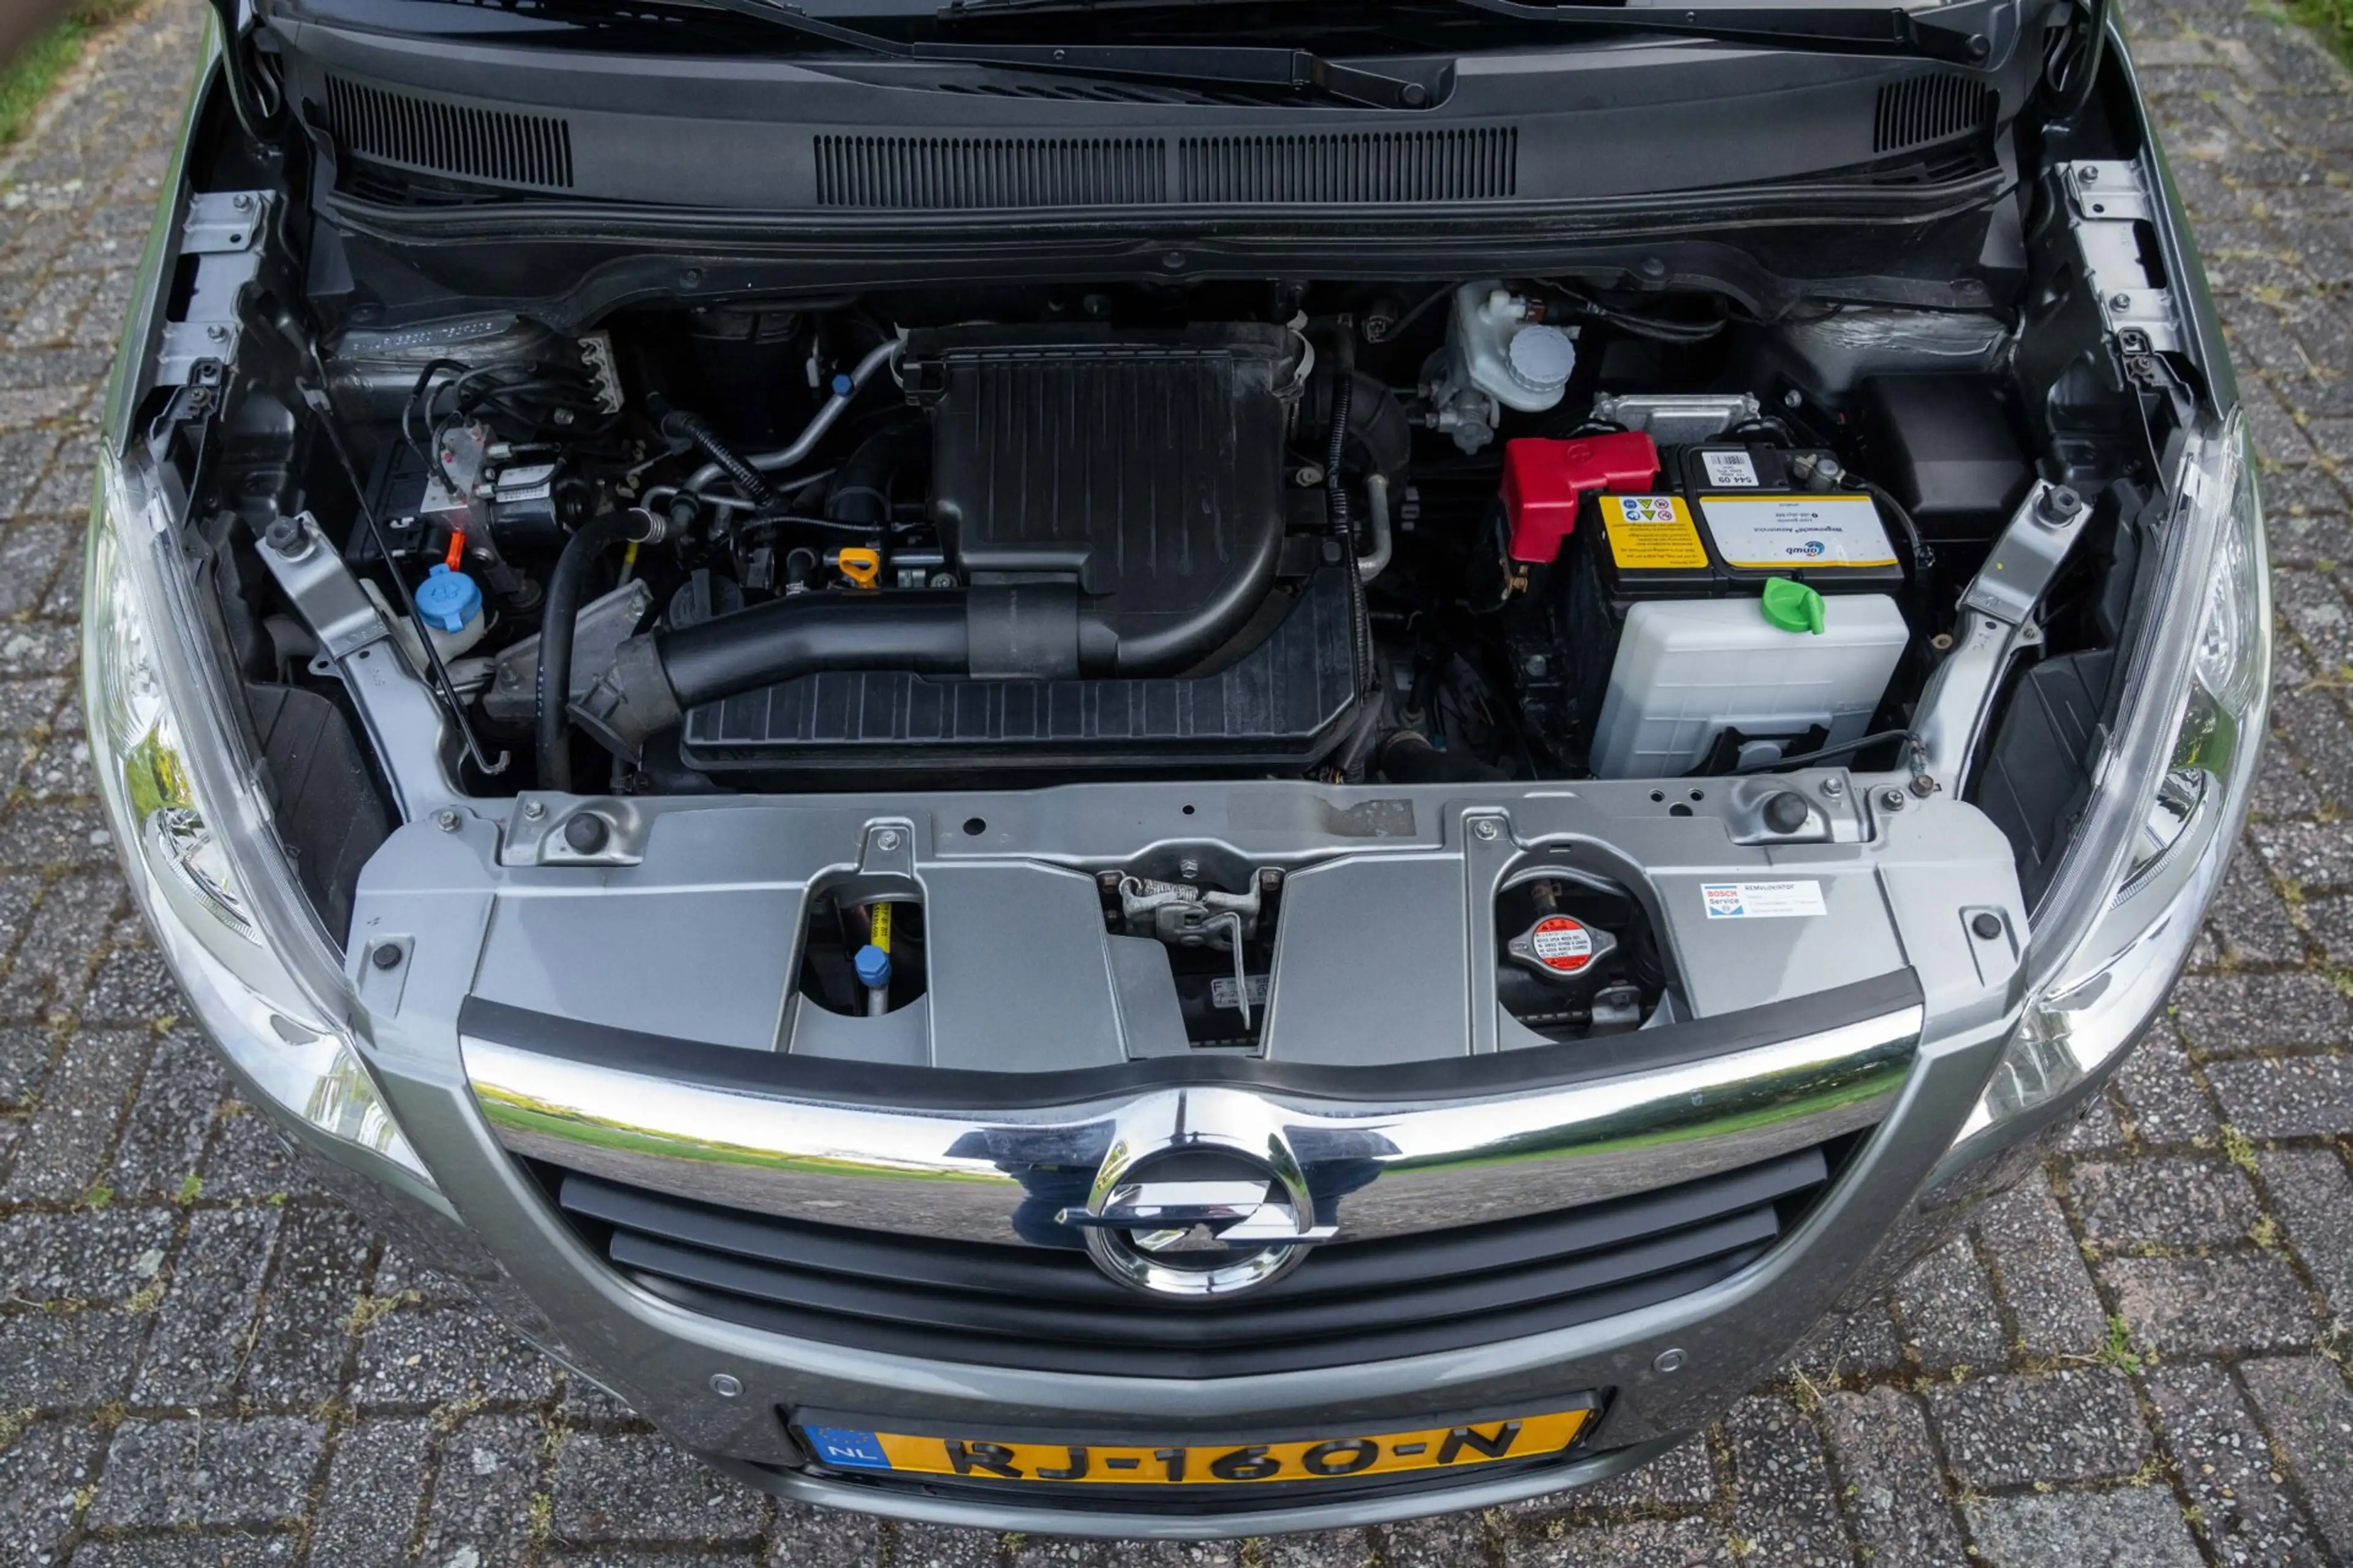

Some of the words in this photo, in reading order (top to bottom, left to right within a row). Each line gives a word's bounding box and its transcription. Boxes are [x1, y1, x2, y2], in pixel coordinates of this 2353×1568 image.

[1786, 547, 1817, 555] anwb
[827, 1444, 878, 1461] NL
[944, 1421, 1522, 1480] RJ-160-N
